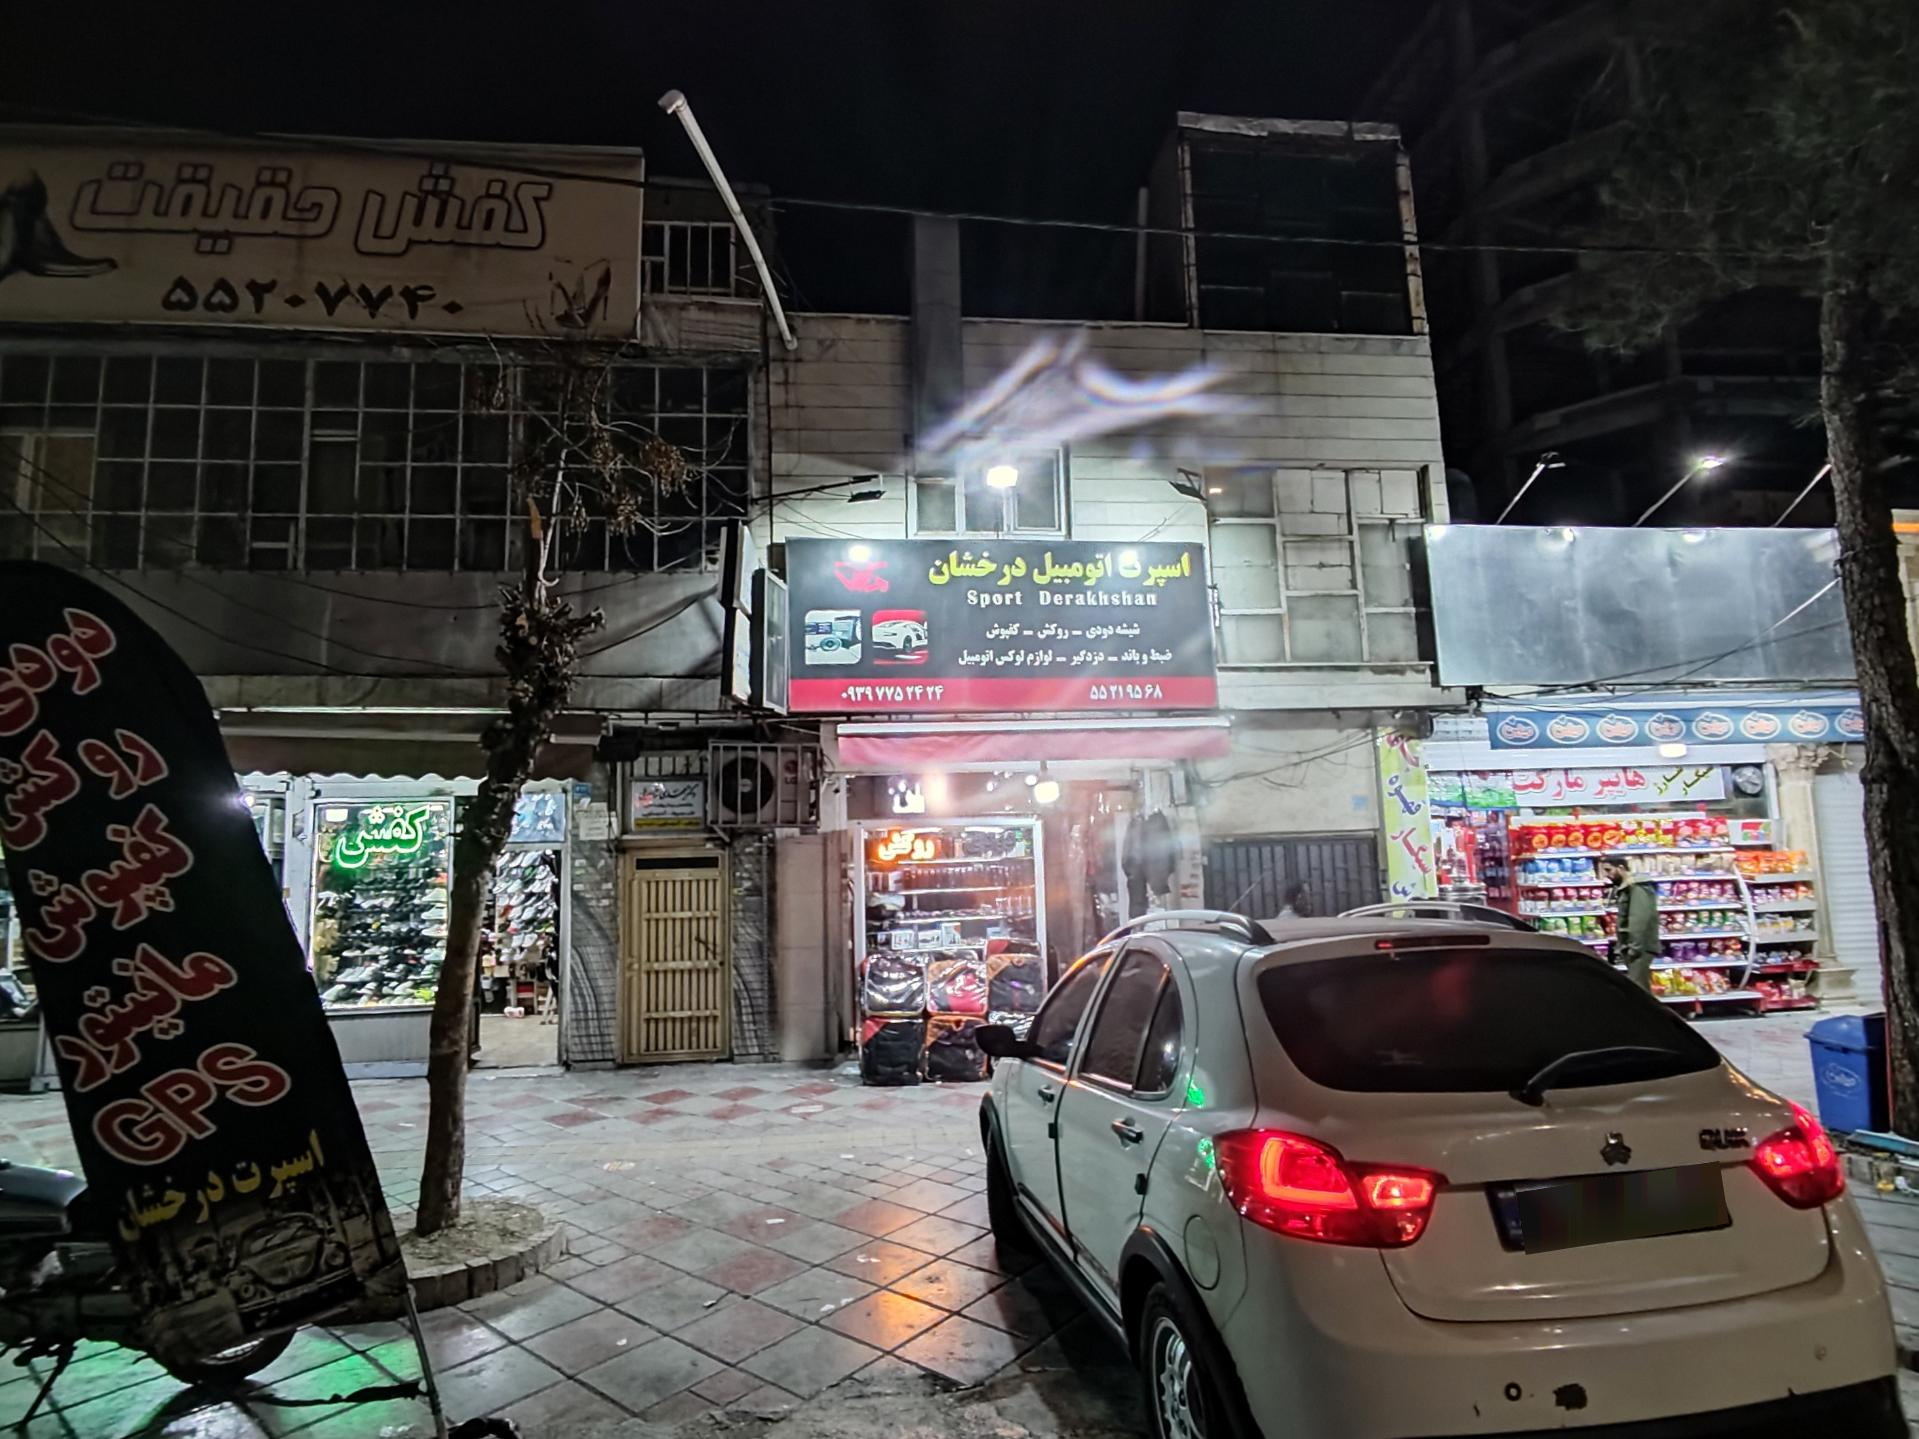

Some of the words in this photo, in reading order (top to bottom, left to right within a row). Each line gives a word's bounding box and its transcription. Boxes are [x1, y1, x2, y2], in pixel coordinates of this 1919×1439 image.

[70, 160, 341, 254] حقیقت
[355, 160, 554, 256] کفش
[160, 275, 464, 320] ۵۵۲۰۷۷۴۰
[927, 549, 1028, 586] درخشان
[1032, 551, 1112, 586] اتومبیل
[1118, 551, 1191, 588] اسپرت
[966, 589, 1024, 609] Sport
[1039, 589, 1158, 607] Derakhshan
[985, 622, 1020, 640] کفپوش
[1036, 622, 1070, 640] روکش
[1085, 625, 1114, 639] دودی
[1115, 622, 1141, 638] شیشه
[958, 649, 993, 666] اتومبیل
[1026, 649, 1053, 667] لوازم
[1069, 649, 1105, 667] دزدگیر
[1150, 648, 1173, 665] ضبط
[335, 805, 430, 869] کفش
[26, 803, 195, 963] کفپوش
[93, 1042, 292, 1166] GPS
[231, 1128, 325, 1199] اسپرت
